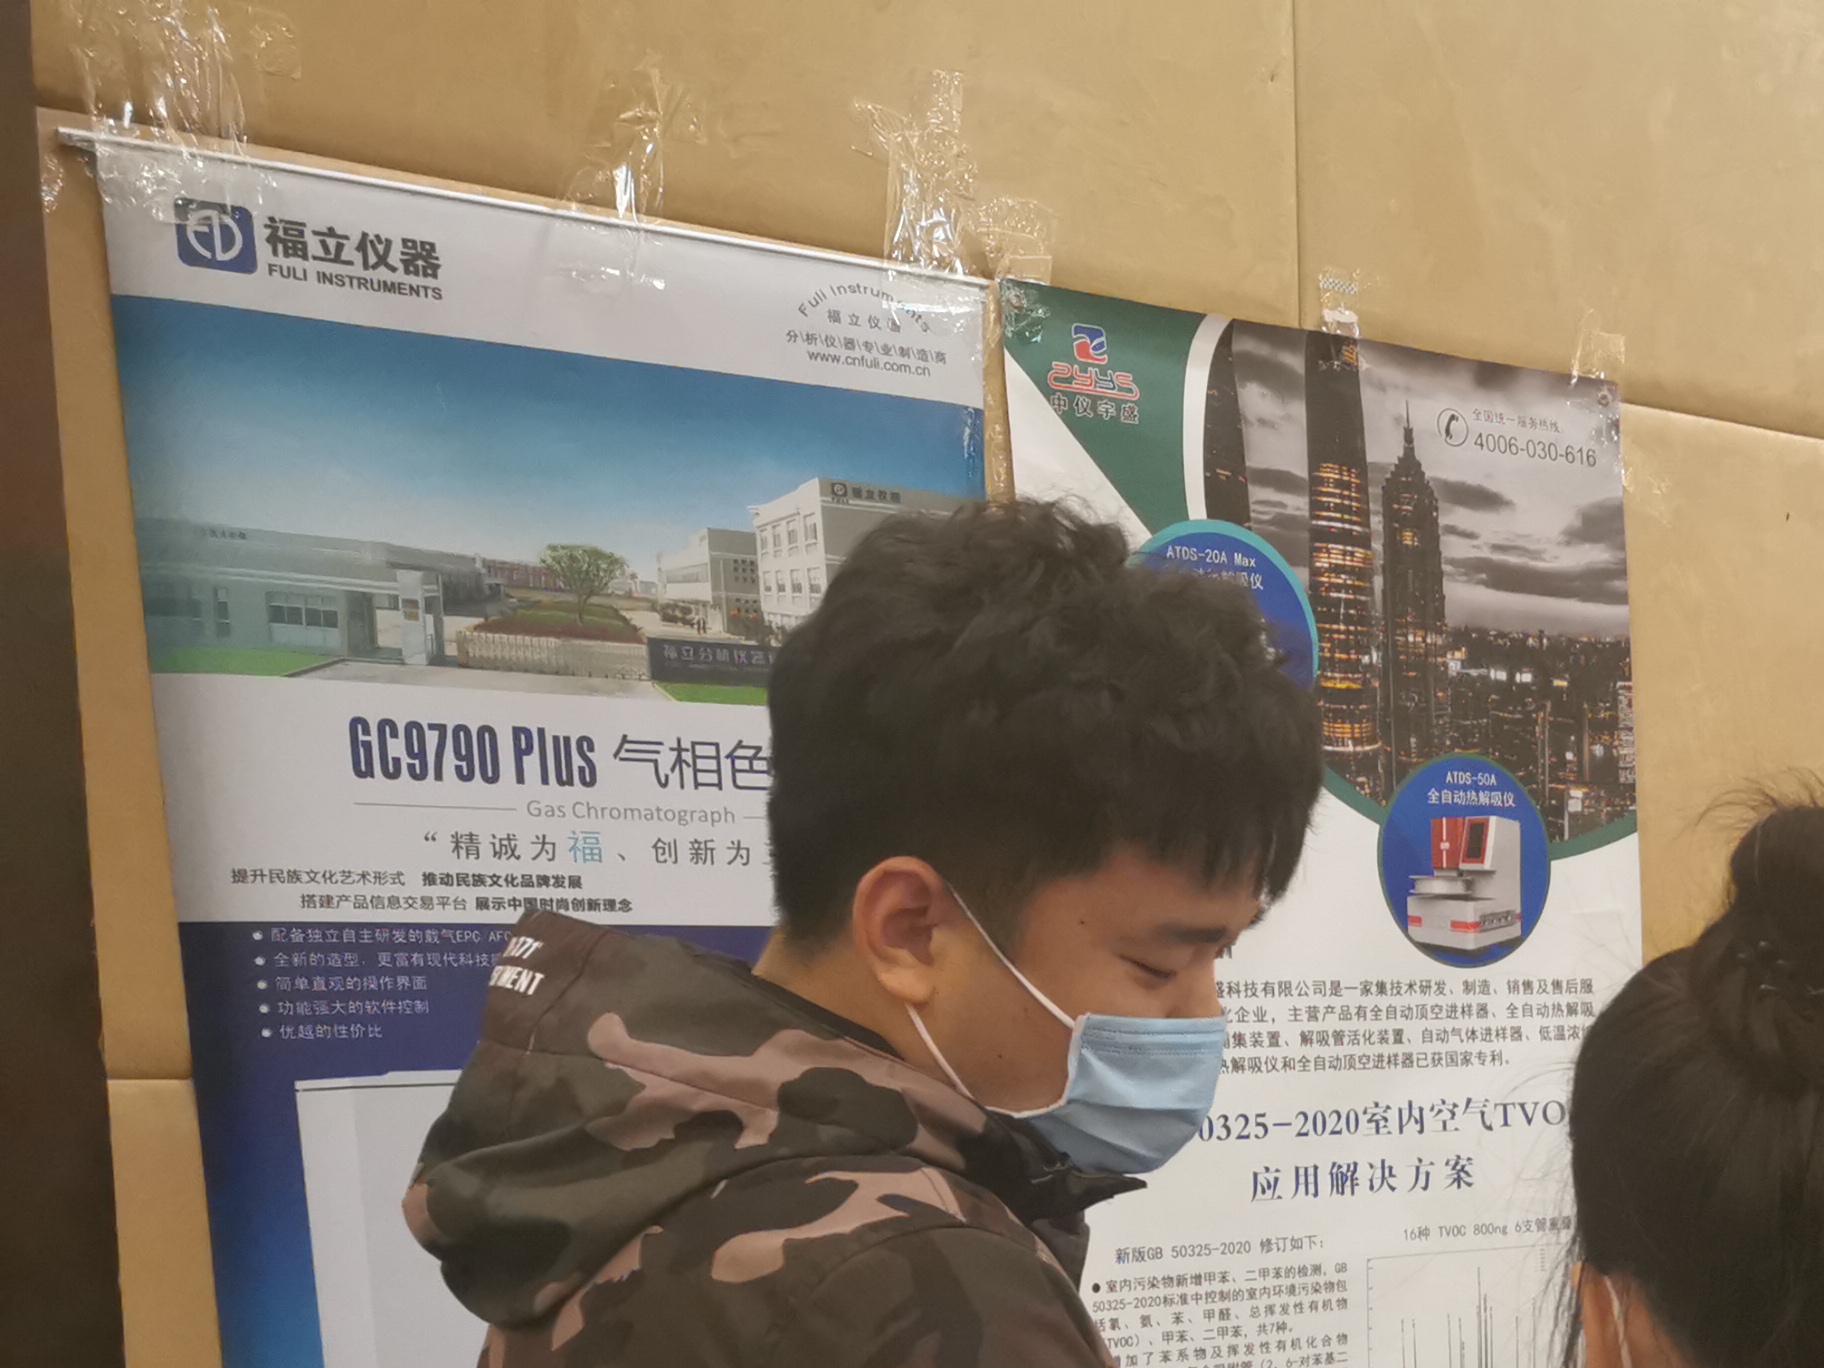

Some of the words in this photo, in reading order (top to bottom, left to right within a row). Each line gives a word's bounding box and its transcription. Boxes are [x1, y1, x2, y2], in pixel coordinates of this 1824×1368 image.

[263, 215, 442, 280] 福立仪器
[267, 262, 308, 282] FULI
[316, 270, 443, 301] INSTRUMENTS
[797, 289, 828, 318] Fuli
[829, 282, 932, 334] Instrumnts
[806, 350, 932, 377] www.cnfuli.com.cn
[1050, 392, 1139, 424] 中仪宇盛
[1473, 432, 1597, 468] 4006-030-616
[1166, 544, 1228, 564] ATDS-20A
[1234, 552, 1256, 568] Max
[348, 716, 501, 785] GC9790
[512, 725, 598, 789] Plus
[612, 733, 772, 791] 气相色
[1445, 771, 1498, 786] ATDS-50A
[1427, 788, 1517, 808] 全自动热解吸仪
[526, 800, 566, 819] Gas
[571, 801, 736, 826] Chromatograph
[423, 830, 770, 866] “精诚为福、创新为
[231, 868, 406, 888] 提升民族文化艺术形式
[422, 871, 583, 890] 推动民族文化品牌发展
[300, 894, 468, 912] 搭建产品信息交易平台
[475, 896, 633, 914] 展示中国时尚创新理念
[275, 975, 428, 992] 简单直观的操作界面
[278, 1000, 430, 1016] 功能强大的软件控制
[280, 1024, 384, 1040] 优越的性价比
[1250, 1153, 1475, 1203] 应用解决方案
[1403, 1224, 1431, 1242] 16种
[1438, 1224, 1467, 1238] TVOC
[1473, 1222, 1508, 1237] 800ng
[1115, 1246, 1164, 1265] 新版GB
[1170, 1240, 1251, 1259] 50325-2020
[1259, 1234, 1325, 1254] 修订如下：
